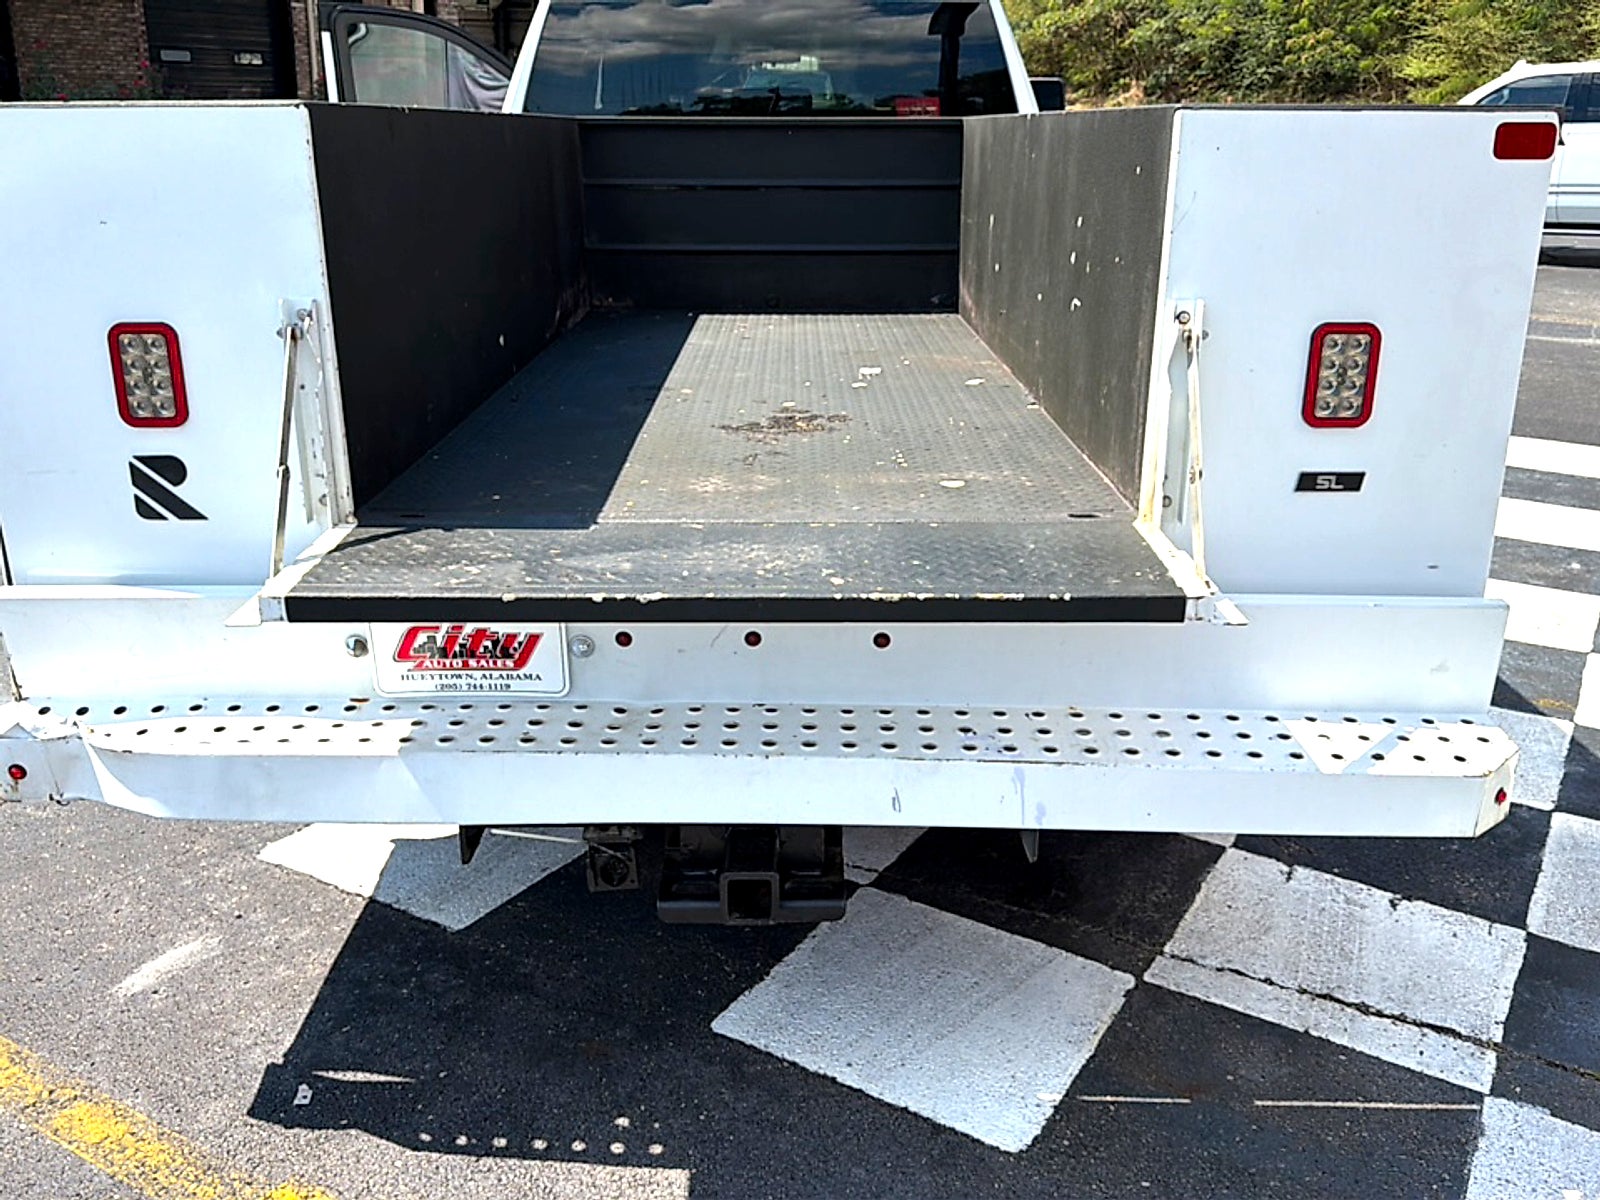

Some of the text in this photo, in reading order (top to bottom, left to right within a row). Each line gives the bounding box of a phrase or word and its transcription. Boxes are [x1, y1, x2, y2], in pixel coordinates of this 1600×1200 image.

[1315, 475, 1344, 489] SL
[393, 624, 543, 671] City
[423, 659, 515, 668] AUTO SALES
[480, 673, 542, 681] ALABAMA
